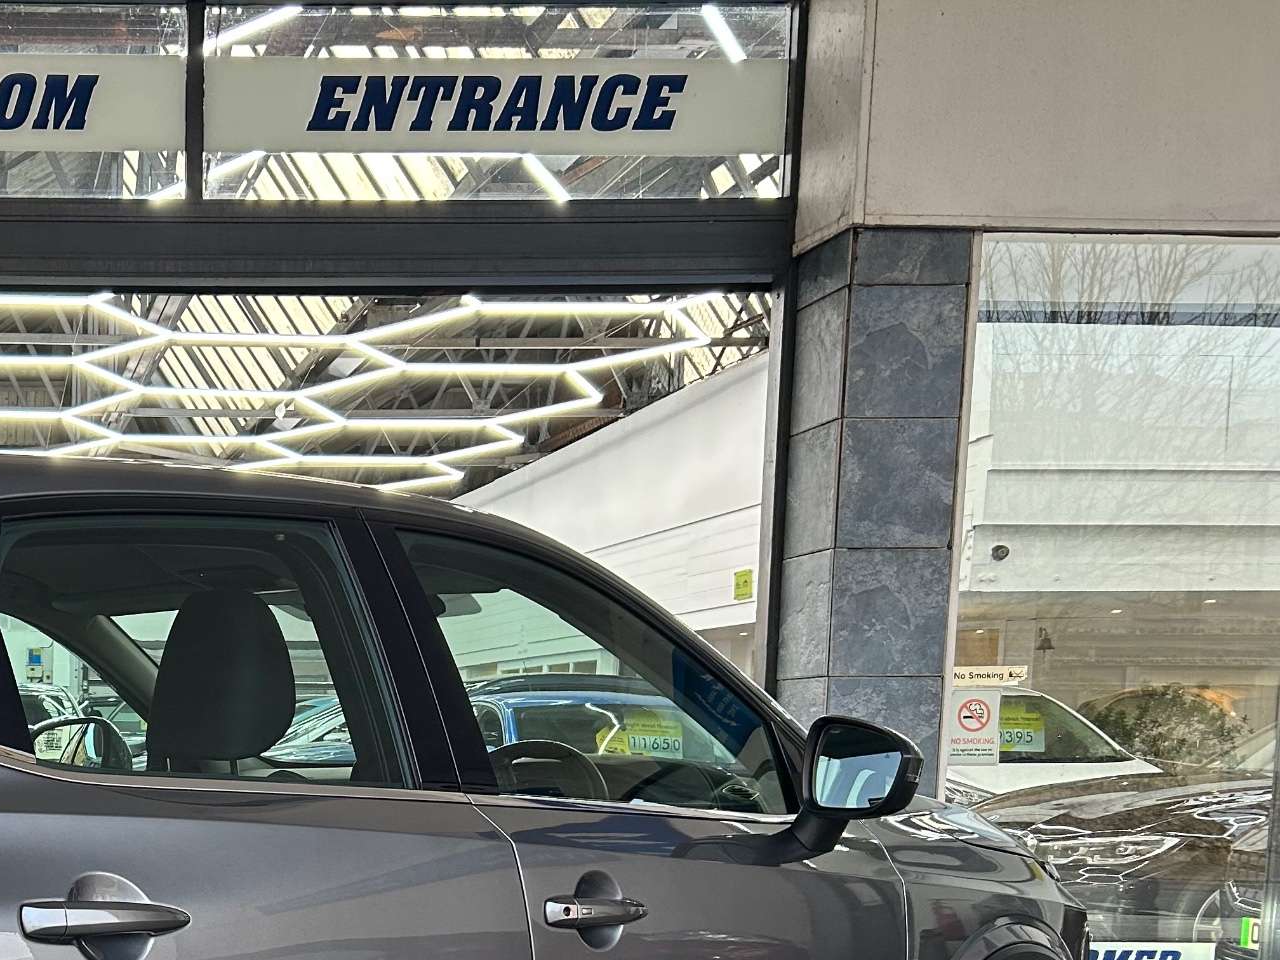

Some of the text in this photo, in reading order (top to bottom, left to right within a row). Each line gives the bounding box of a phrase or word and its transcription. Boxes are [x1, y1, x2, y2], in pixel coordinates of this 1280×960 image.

[305, 74, 689, 132] ENTRANCE
[953, 671, 1004, 681] No Smoking
[631, 736, 680, 751] 11650
[950, 737, 994, 745] NO SMOKING
[999, 730, 1033, 744] 395
